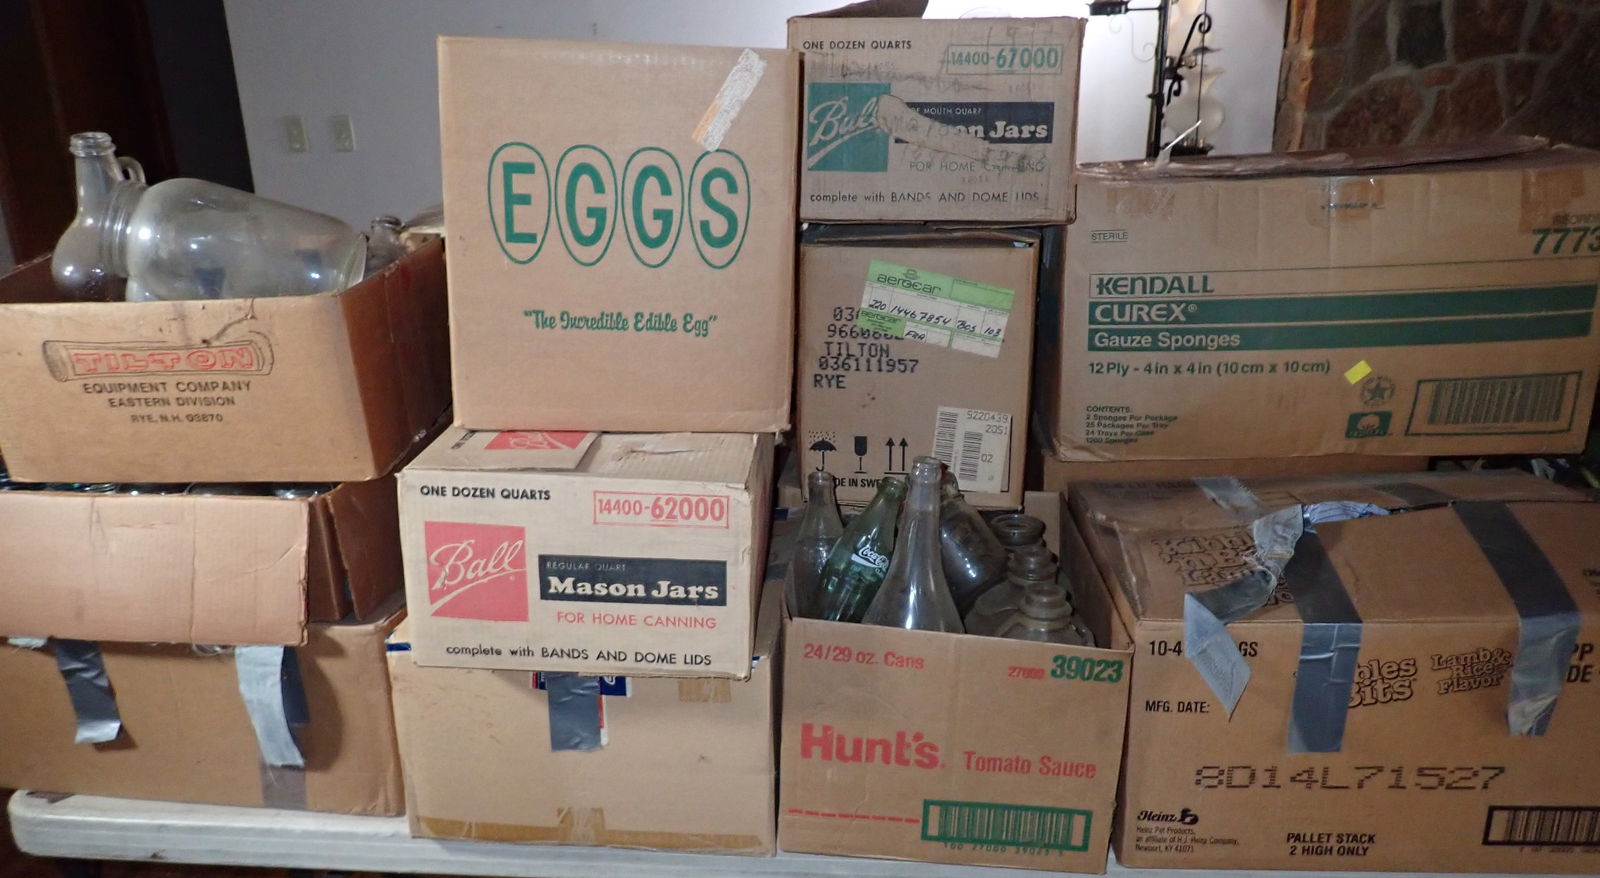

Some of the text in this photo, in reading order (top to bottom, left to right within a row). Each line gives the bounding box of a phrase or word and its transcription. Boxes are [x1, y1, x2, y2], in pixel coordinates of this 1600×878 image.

[803, 40, 912, 50] ONE DOZEN QUARTS
[950, 48, 1059, 69] 14400-67000
[924, 107, 951, 115] MOUTH
[989, 121, 1048, 138] Jars
[910, 161, 932, 172] FOR
[940, 161, 975, 172] HOME
[502, 161, 739, 249] EGGS
[810, 192, 857, 204] complete
[863, 191, 885, 201] with
[891, 192, 931, 201] BANDS
[938, 192, 965, 201] AND
[972, 192, 1009, 201] DOME
[1091, 232, 1128, 241] STERILE
[877, 273, 942, 295] aerocar
[1097, 275, 1214, 295] KENDALL
[868, 299, 887, 310] 220
[560, 311, 629, 332] Incredible
[634, 312, 677, 332] Edible
[1094, 331, 1241, 350] Gauze Sponges
[825, 341, 889, 358] TILTON
[73, 347, 255, 373] TILTON
[818, 357, 919, 373] 036111957
[1088, 362, 1104, 374] 12
[1107, 362, 1129, 377] Ply
[1143, 362, 1152, 374] 4
[1154, 362, 1168, 374] in
[1173, 365, 1183, 374] x
[1187, 362, 1196, 374] 4
[1198, 362, 1212, 374] in
[1268, 364, 1278, 374] x
[1285, 361, 1299, 373] 10
[83, 381, 252, 394] EQUIPMENT COMPANY
[813, 374, 846, 389] RYE
[108, 396, 235, 407] EASTERN DIVISION
[185, 414, 223, 423] 03870
[849, 478, 857, 487] IN
[420, 485, 551, 501] ONE DOZEN QUARTS
[598, 497, 725, 521] 14400-62000
[430, 539, 527, 591] Ball
[546, 561, 626, 571] REGULAR QUART
[548, 576, 719, 601] Mason Jars
[557, 611, 717, 630] FOR HOME CANNING
[446, 644, 712, 666] complete with BANDS AND DOME LIDS
[803, 643, 852, 663] 24/29
[884, 651, 924, 670] Cans
[1051, 654, 1124, 683] 39023
[1452, 663, 1496, 678] Rice
[1438, 674, 1505, 695] Flavor
[1145, 700, 1209, 714] MFG. DATE:
[801, 722, 1097, 780] Hunt's Tomato Sauce
[1137, 809, 1178, 823] Heinz
[1287, 833, 1376, 845] PALLET STACK
[1288, 845, 1370, 857] 2 HIGH ONLY
